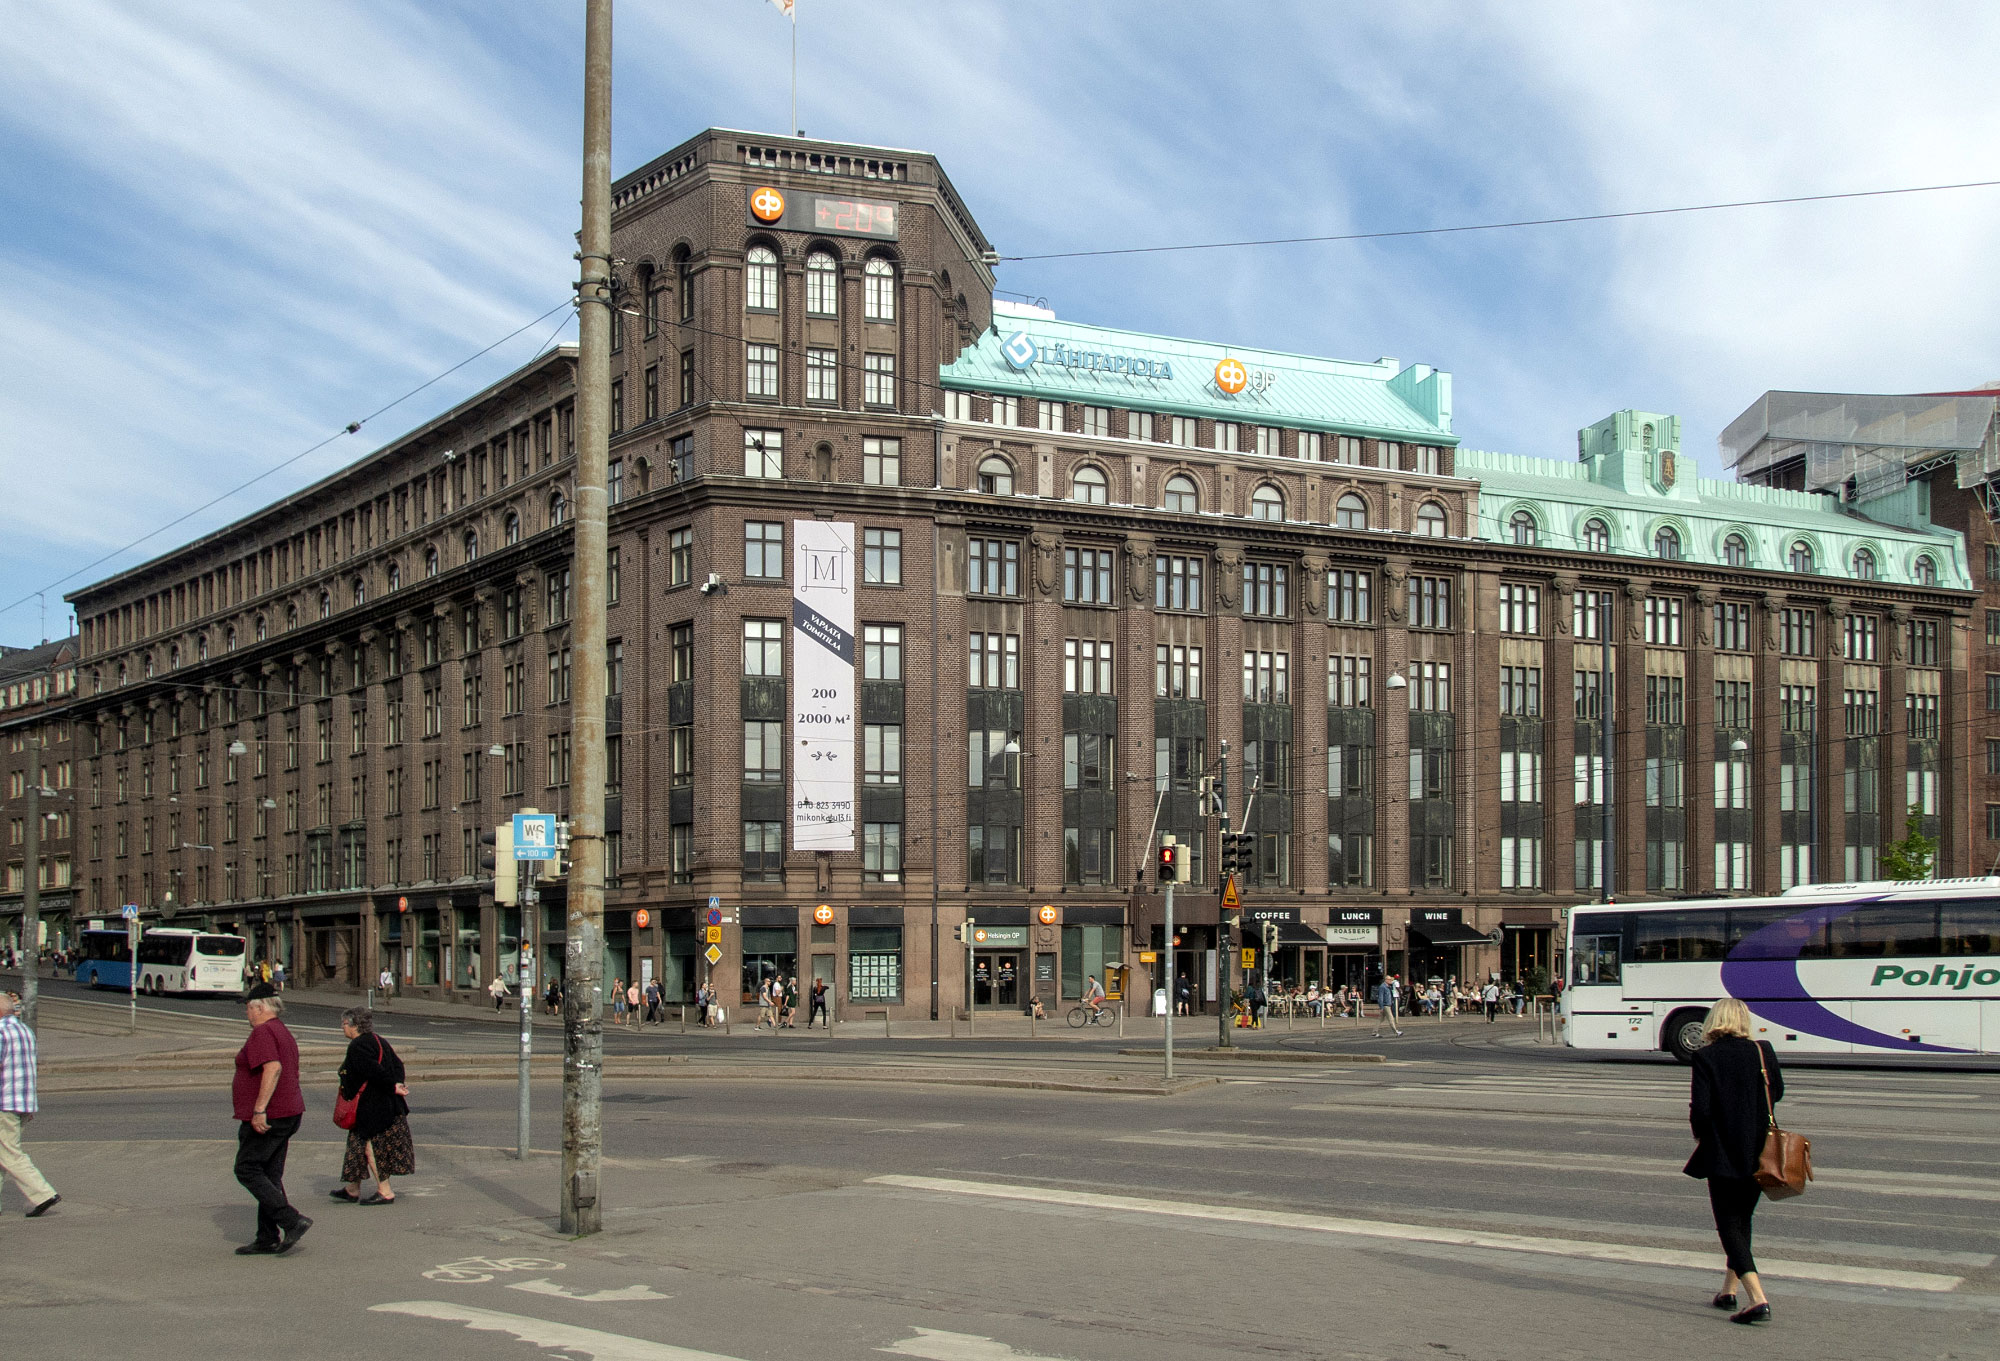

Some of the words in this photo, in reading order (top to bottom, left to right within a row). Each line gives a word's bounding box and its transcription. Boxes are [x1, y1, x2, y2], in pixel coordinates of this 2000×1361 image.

[1042, 343, 1173, 380] LÄHITAPIOLA
[812, 555, 837, 581] M
[811, 614, 842, 640] VAPAATA
[802, 619, 842, 651] TOIMITILAA
[811, 688, 837, 699] 200
[797, 713, 832, 724] 2000
[816, 801, 829, 809] 823
[832, 801, 851, 809] 3490
[527, 849, 539, 857] 100
[1254, 912, 1291, 920] COFFEE
[1424, 912, 1448, 920] WINE
[987, 932, 1011, 940] Helsingin
[1870, 963, 2000, 990] Pohjo
[1627, 1017, 1643, 1025] 172
